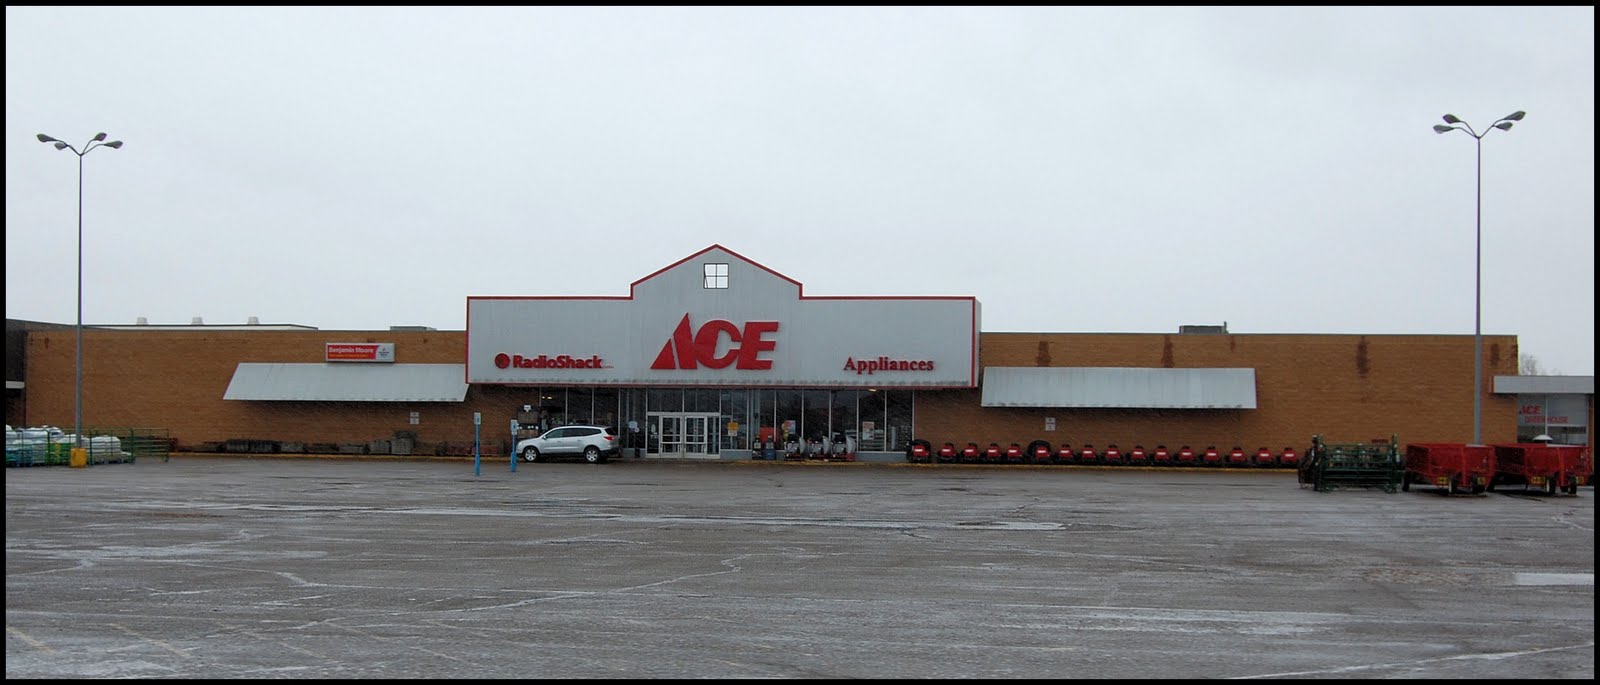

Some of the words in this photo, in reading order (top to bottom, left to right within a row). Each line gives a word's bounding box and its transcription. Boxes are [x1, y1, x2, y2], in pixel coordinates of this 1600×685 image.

[650, 312, 779, 369] ACE
[328, 346, 355, 354] Benjamin
[512, 354, 603, 369] RadioShack
[843, 356, 934, 375] Appliances
[1518, 404, 1541, 415] ACE
